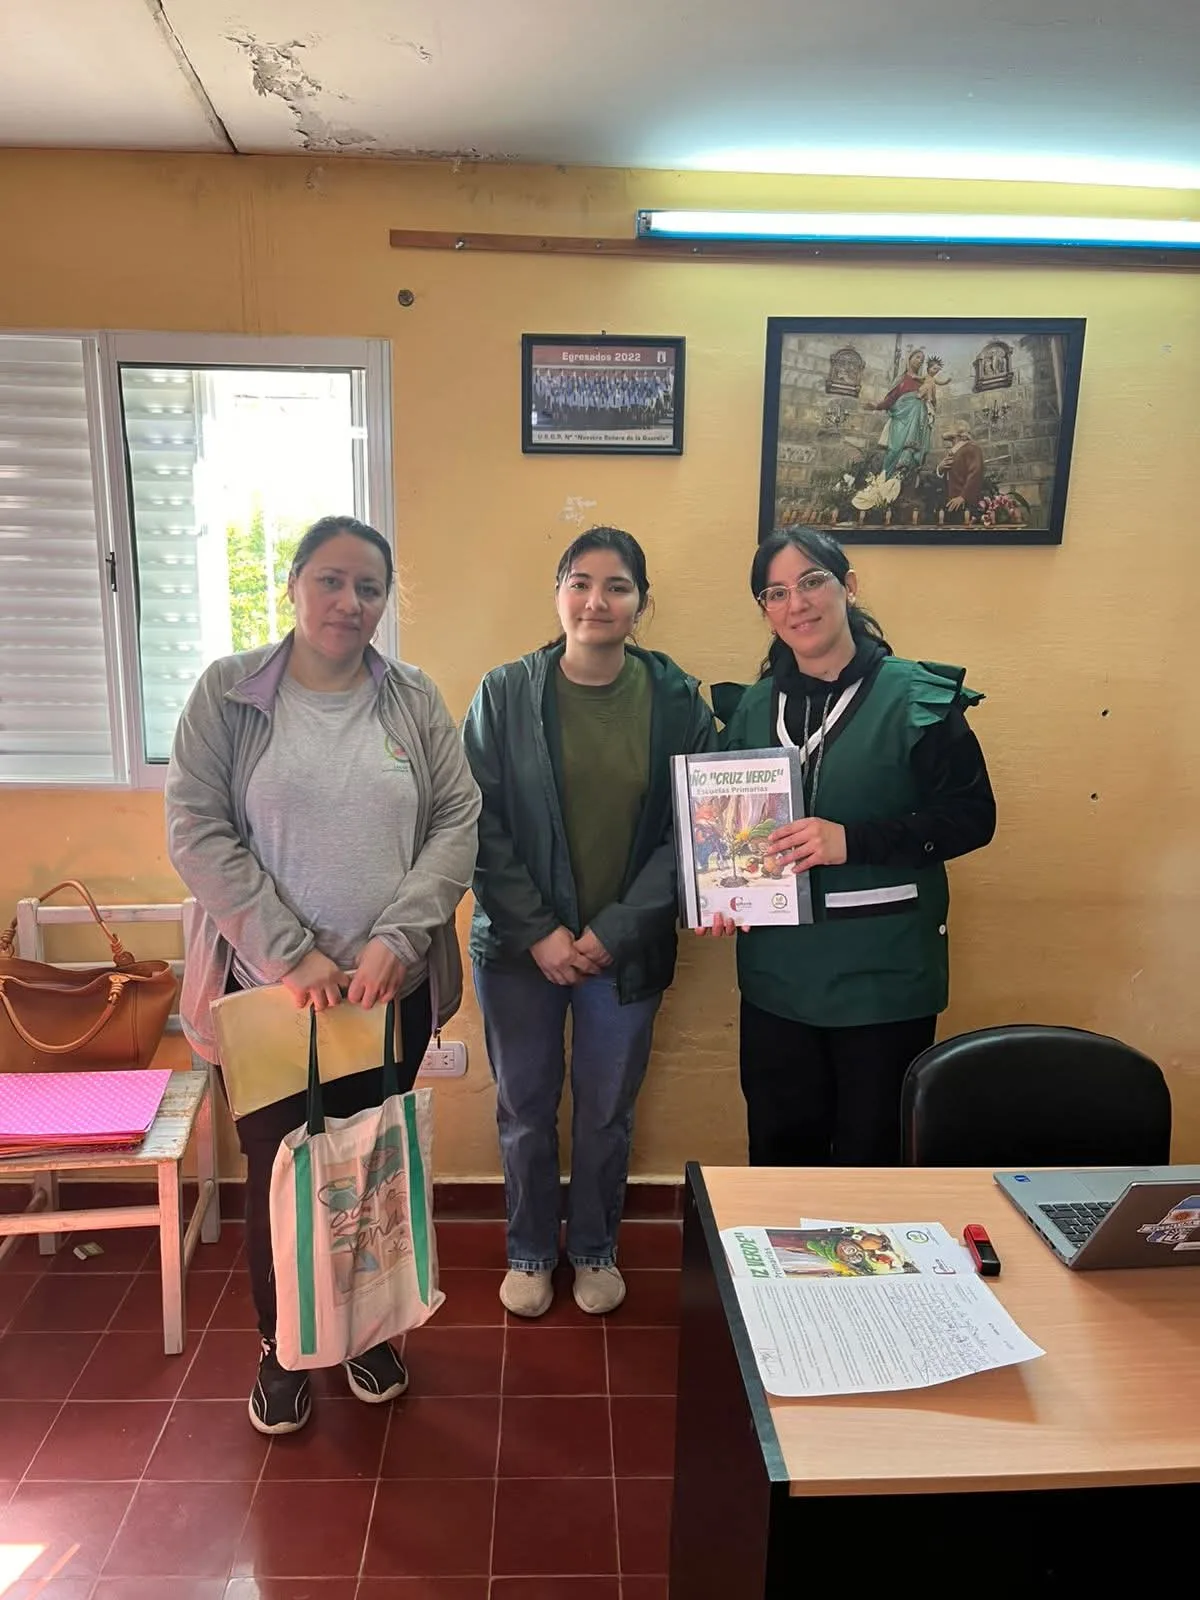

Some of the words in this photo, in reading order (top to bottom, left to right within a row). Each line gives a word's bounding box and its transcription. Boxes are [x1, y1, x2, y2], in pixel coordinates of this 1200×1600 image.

[562, 351, 612, 362] Egresados
[615, 352, 641, 362] 2022
[710, 771, 745, 785] "CRUZ
[745, 768, 784, 784] VERDE"
[733, 1232, 765, 1267] VERDE"
